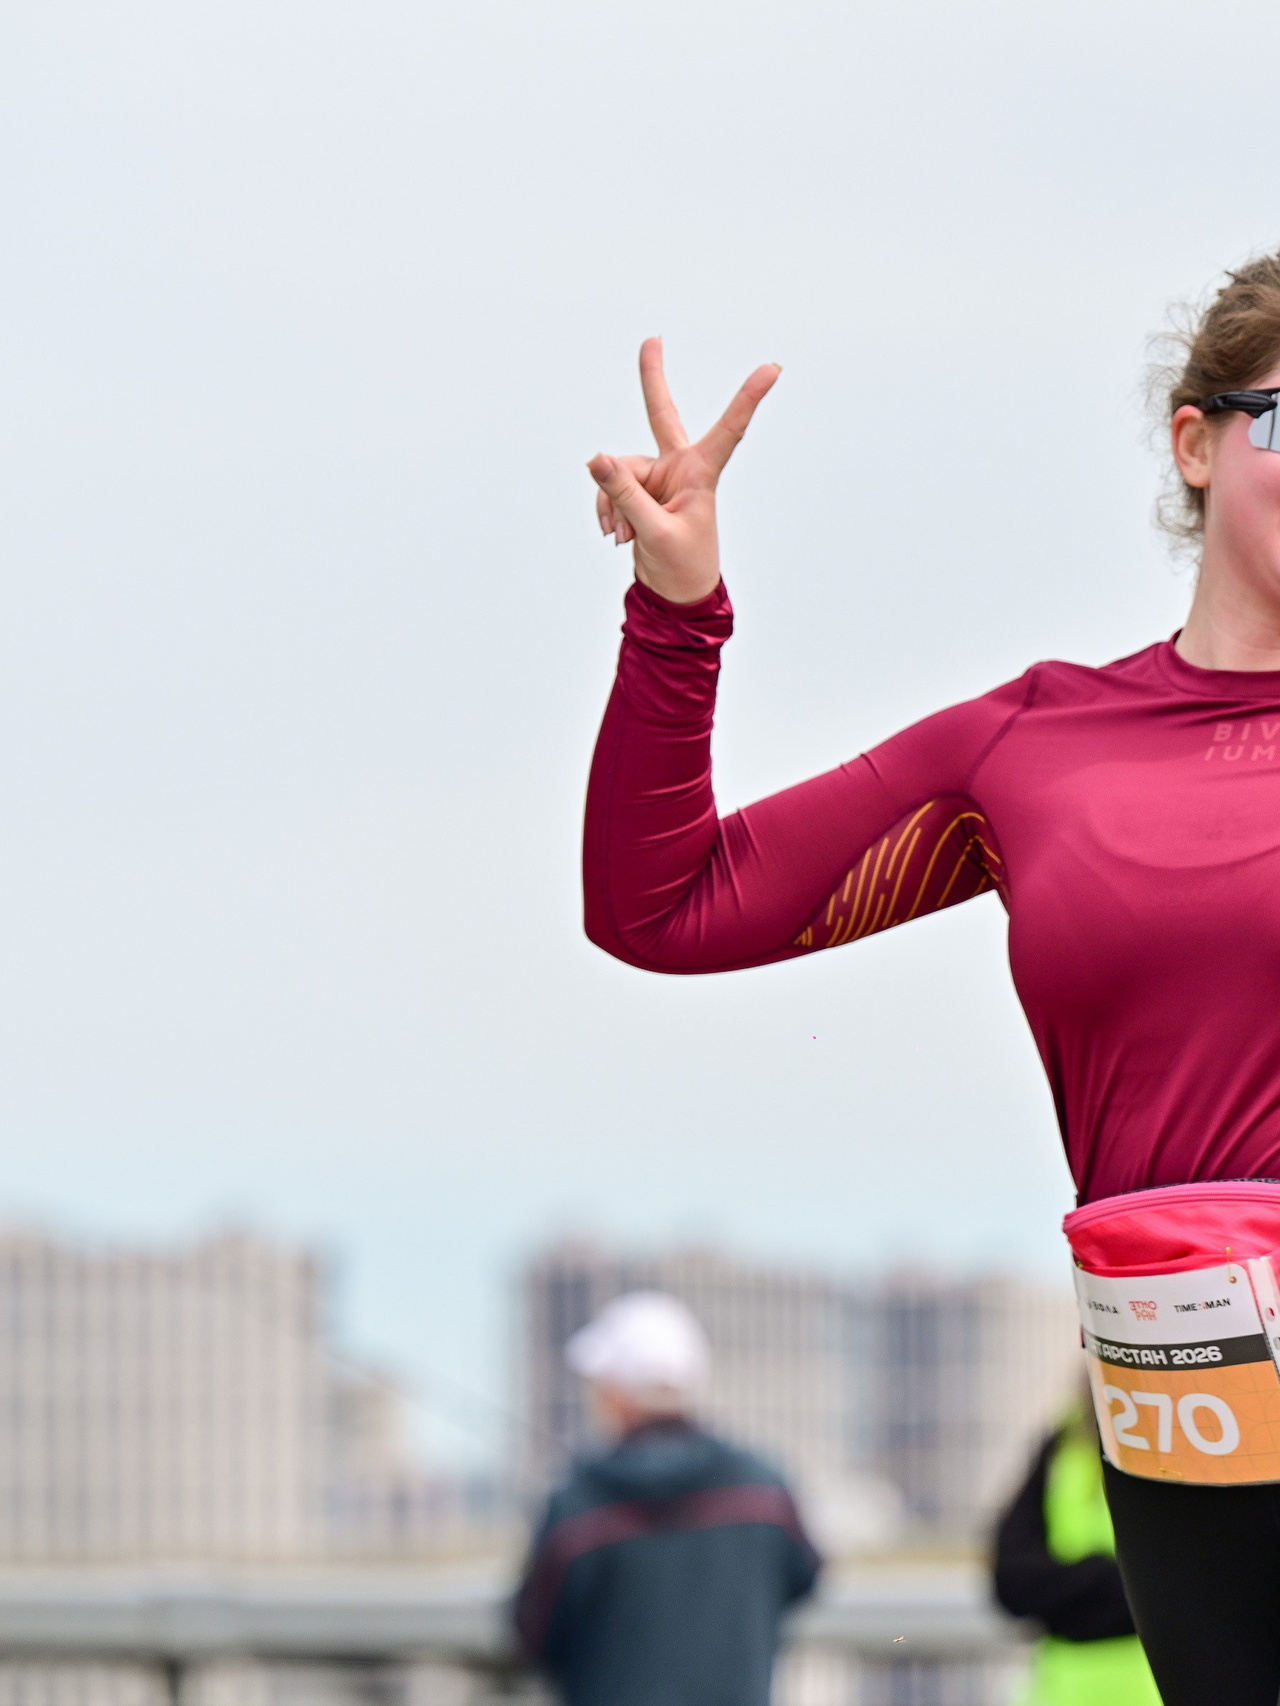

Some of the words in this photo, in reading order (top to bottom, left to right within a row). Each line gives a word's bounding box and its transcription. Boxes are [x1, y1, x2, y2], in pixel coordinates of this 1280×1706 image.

[1204, 745, 1277, 761] IUM
[1170, 1346, 1223, 1365] 2026
[1104, 1384, 1240, 1456] 270
